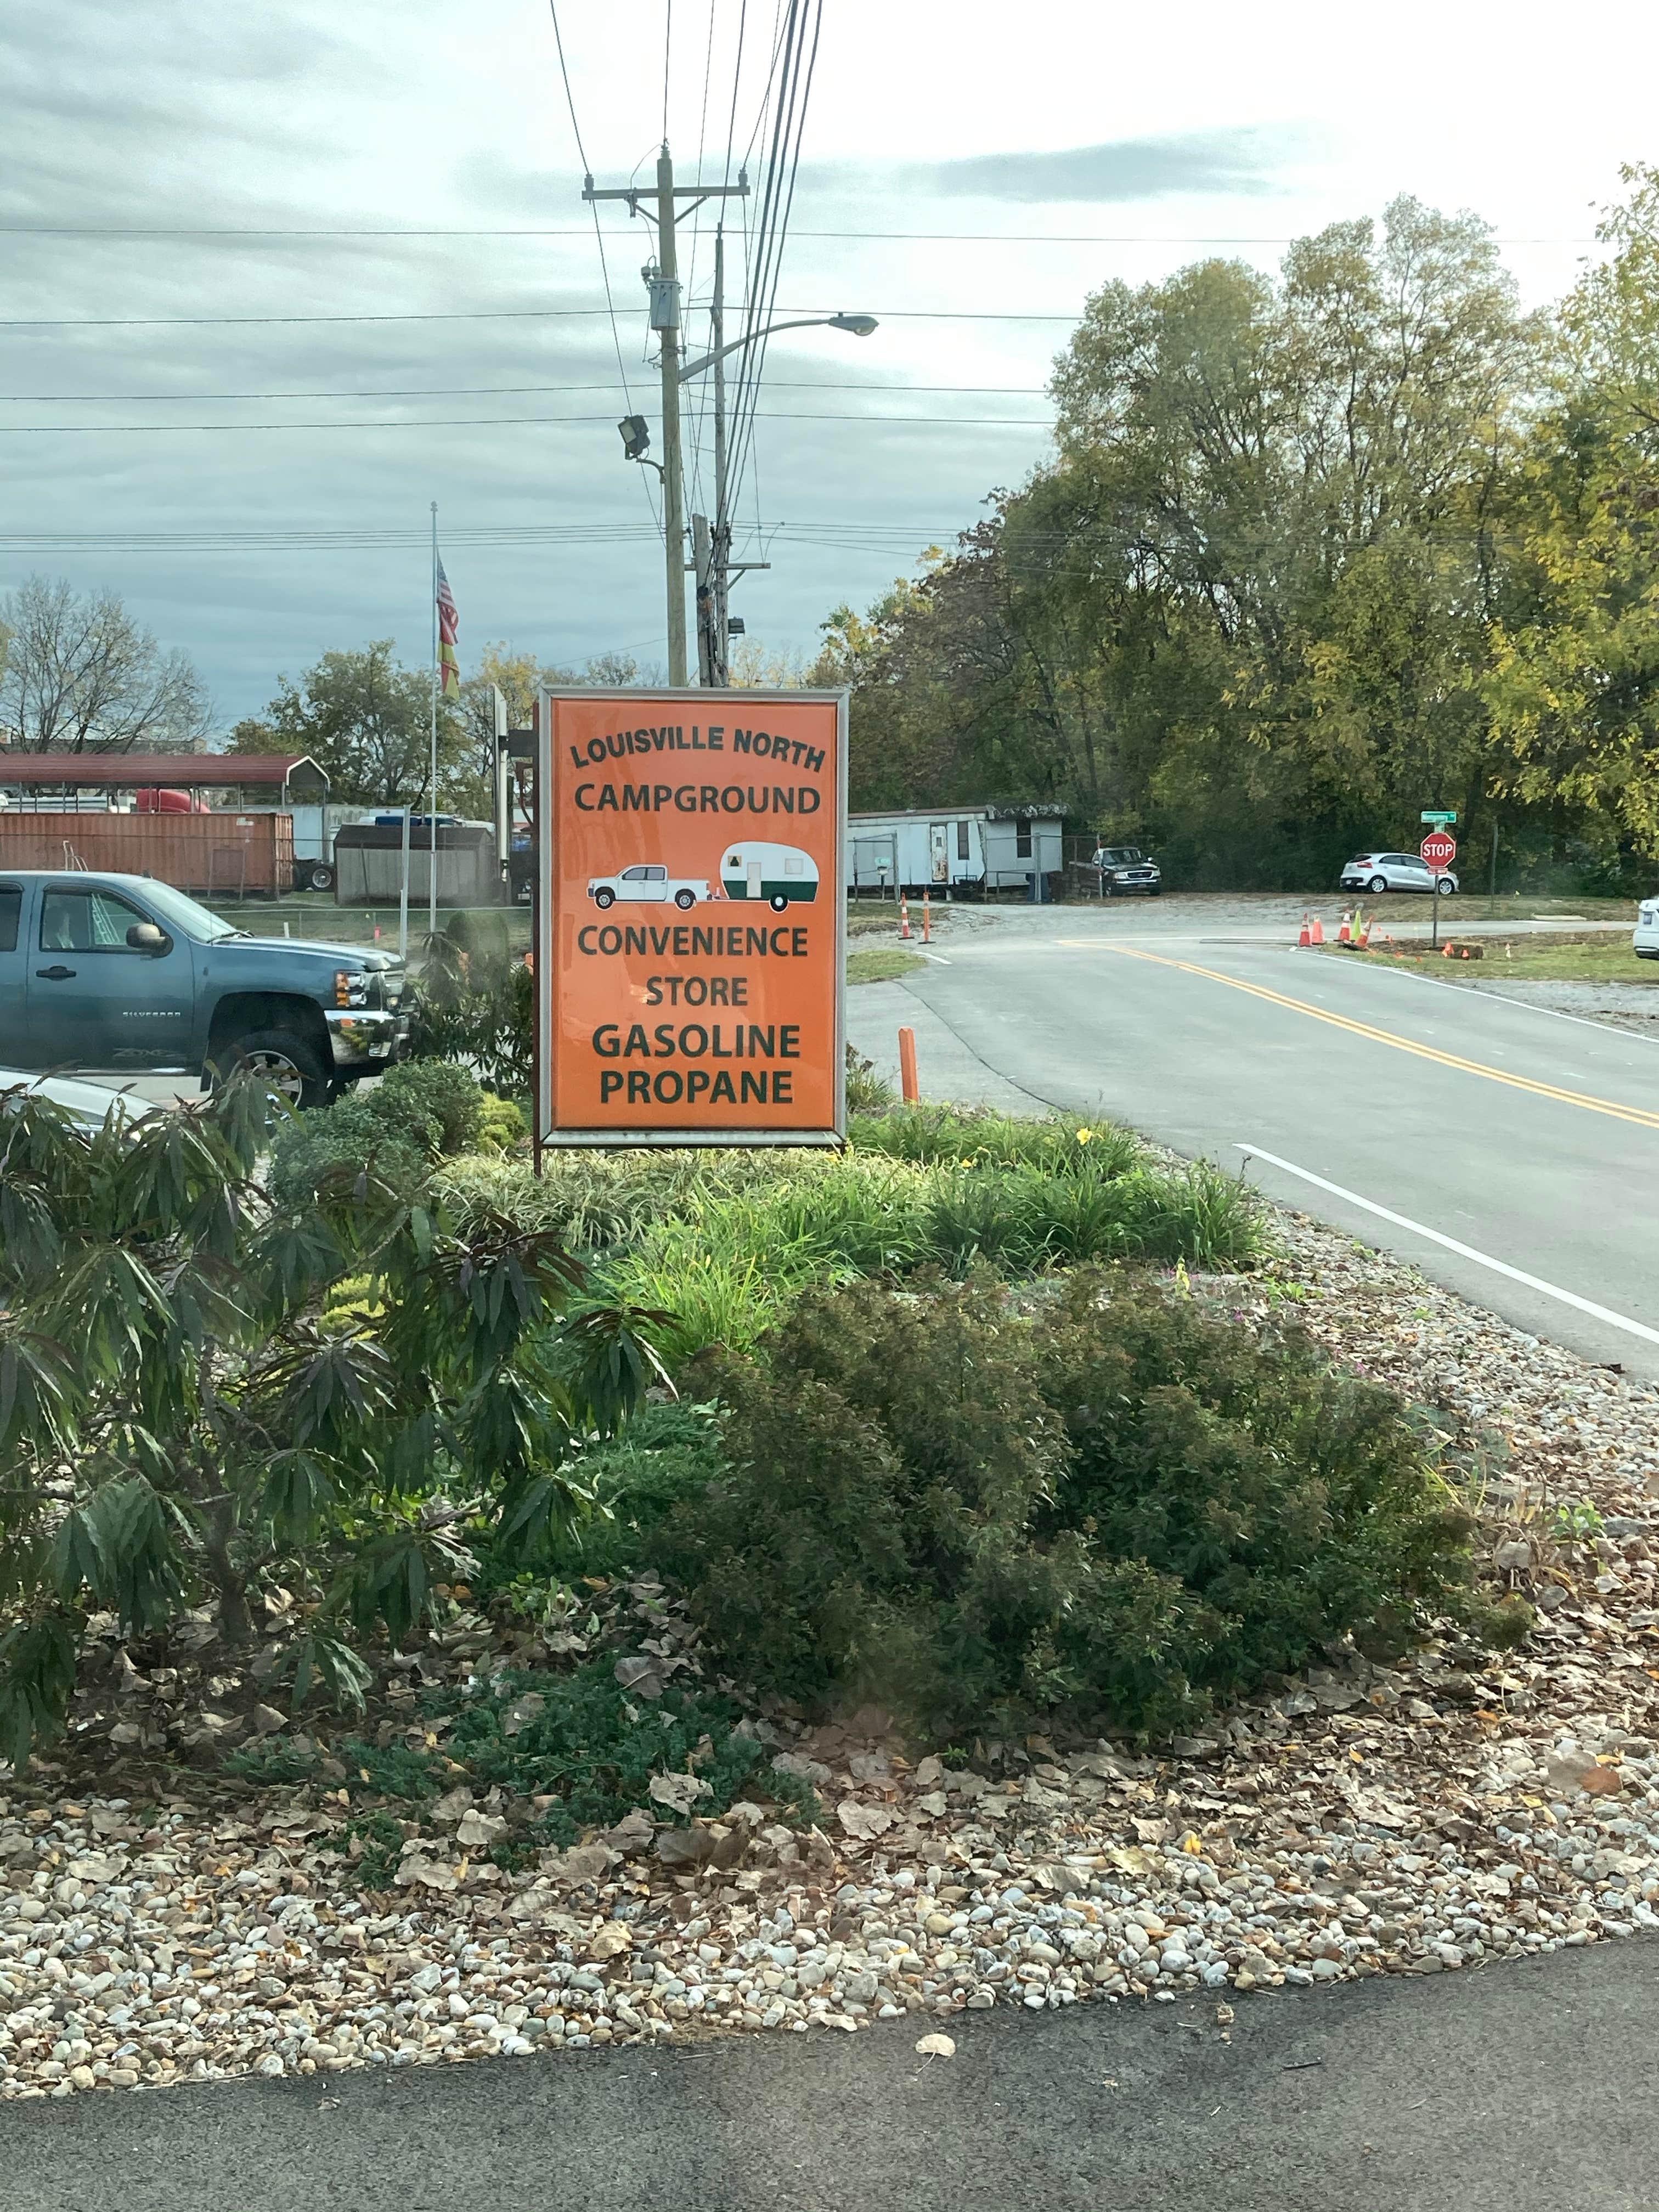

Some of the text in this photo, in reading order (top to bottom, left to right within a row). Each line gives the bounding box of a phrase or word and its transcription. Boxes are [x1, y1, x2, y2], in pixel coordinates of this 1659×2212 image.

[570, 726, 825, 772] LOUISVILLE NORTH
[575, 783, 820, 814] CAMPGROUND
[1423, 844, 1453, 856] STOP
[578, 926, 808, 956] CONVENIENCE
[647, 977, 747, 1006] STORE
[592, 1024, 800, 1058] GASOLINE
[601, 1070, 792, 1104] PROPANE
